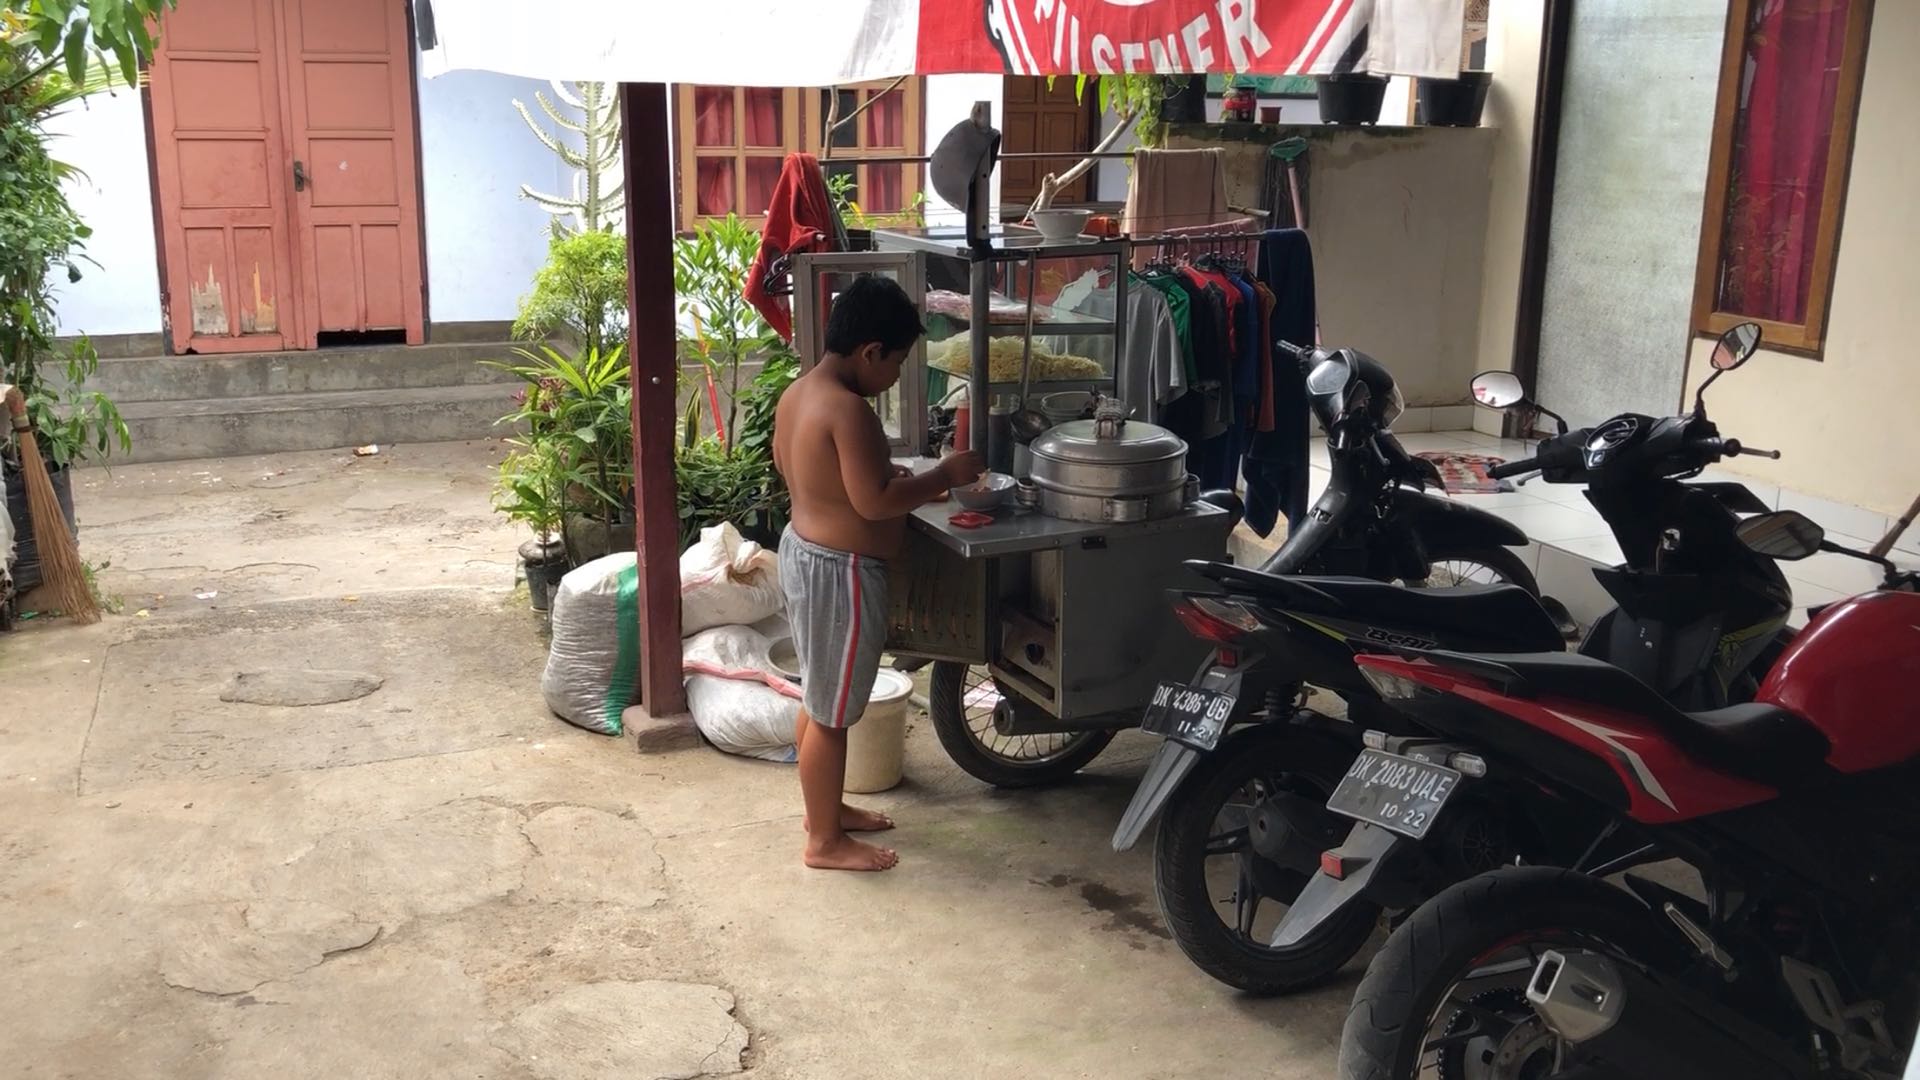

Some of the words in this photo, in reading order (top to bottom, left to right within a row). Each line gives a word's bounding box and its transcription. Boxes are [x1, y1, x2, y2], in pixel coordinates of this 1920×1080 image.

[1153, 685, 1173, 707] DK
[1173, 690, 1205, 714] 4386
[1206, 697, 1229, 720] UB
[1349, 755, 1376, 780] DK
[1370, 759, 1417, 790] 2083
[1410, 770, 1453, 802] UAE
